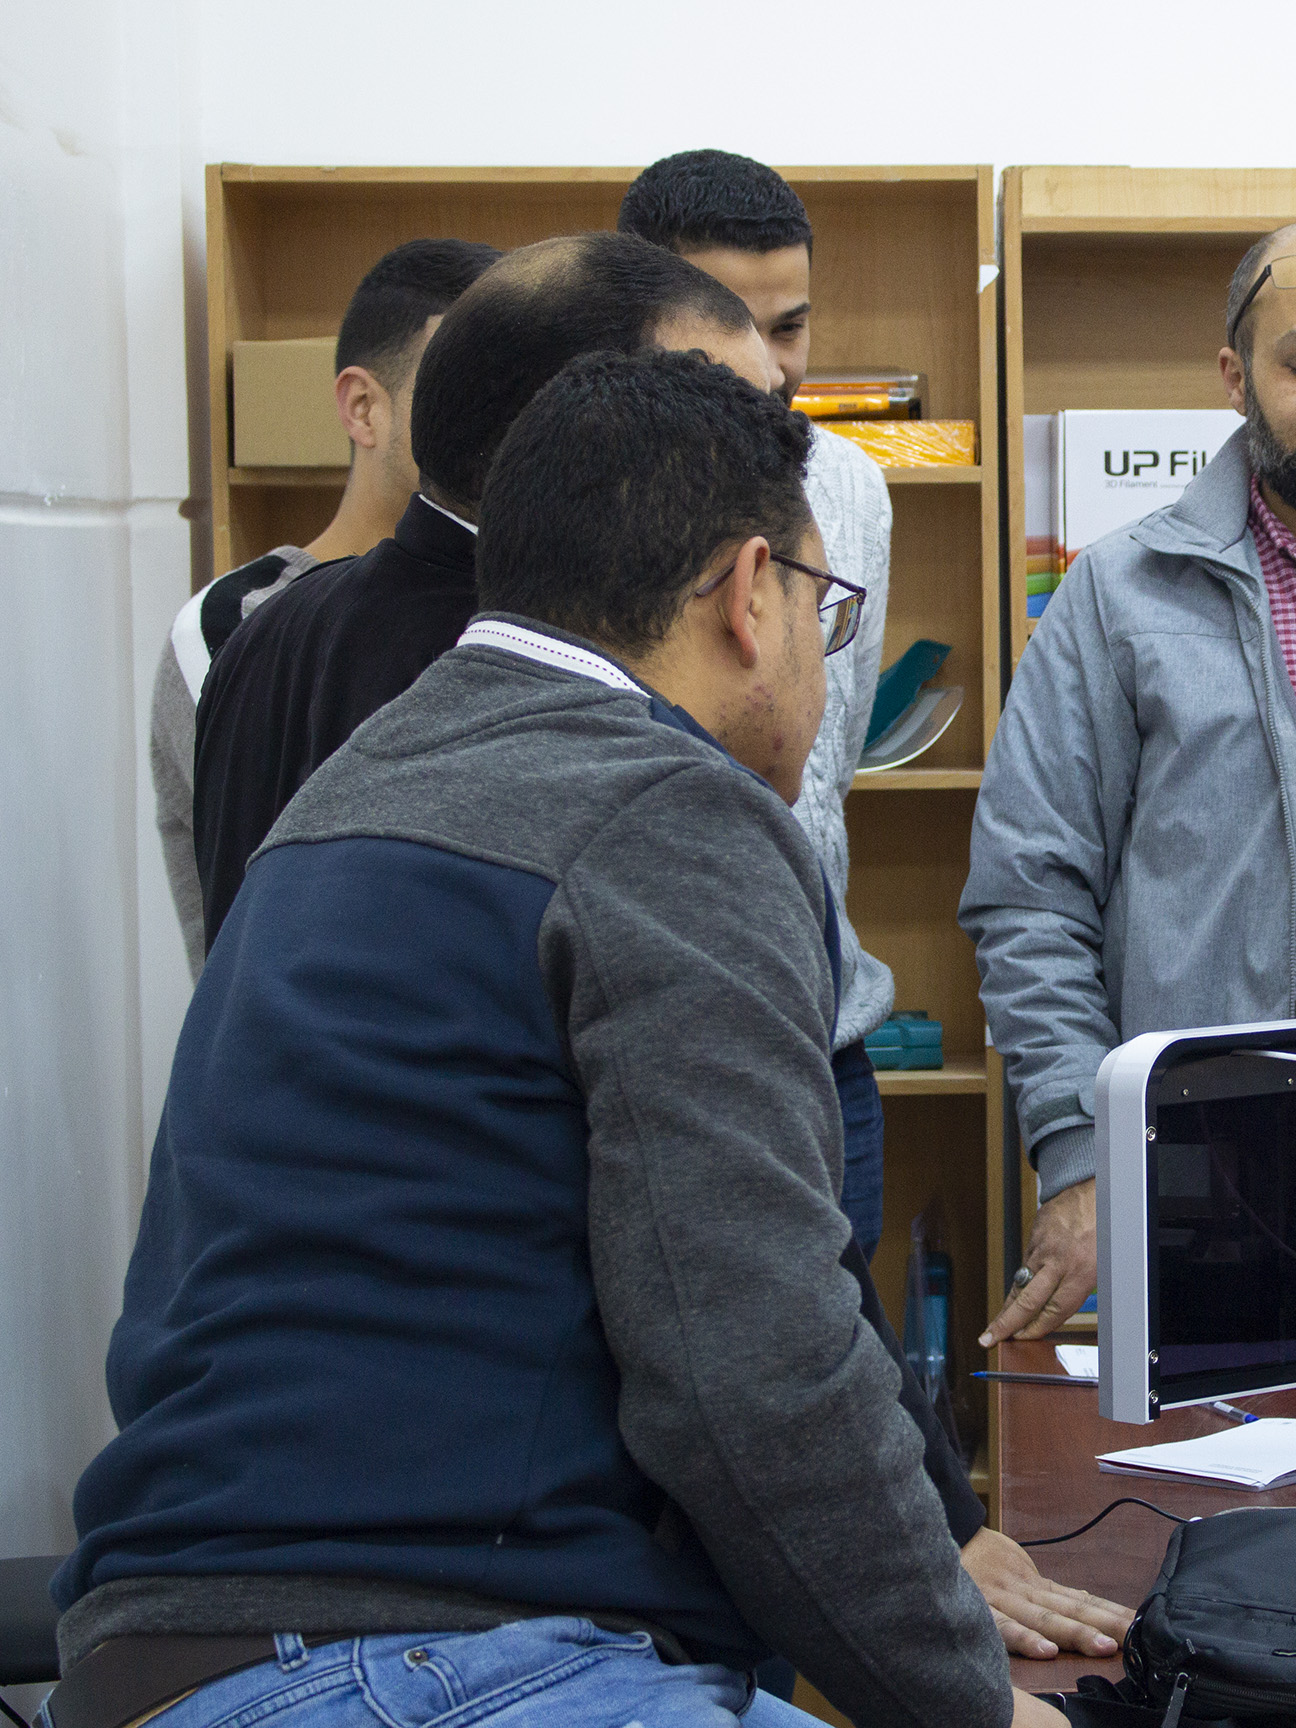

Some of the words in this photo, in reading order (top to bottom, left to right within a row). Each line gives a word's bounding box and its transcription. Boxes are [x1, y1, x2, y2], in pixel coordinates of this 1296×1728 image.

[1104, 450, 1160, 476] UP
[1170, 450, 1207, 476] Fil
[1104, 479, 1118, 489] 3D
[1119, 479, 1158, 489] Filament
